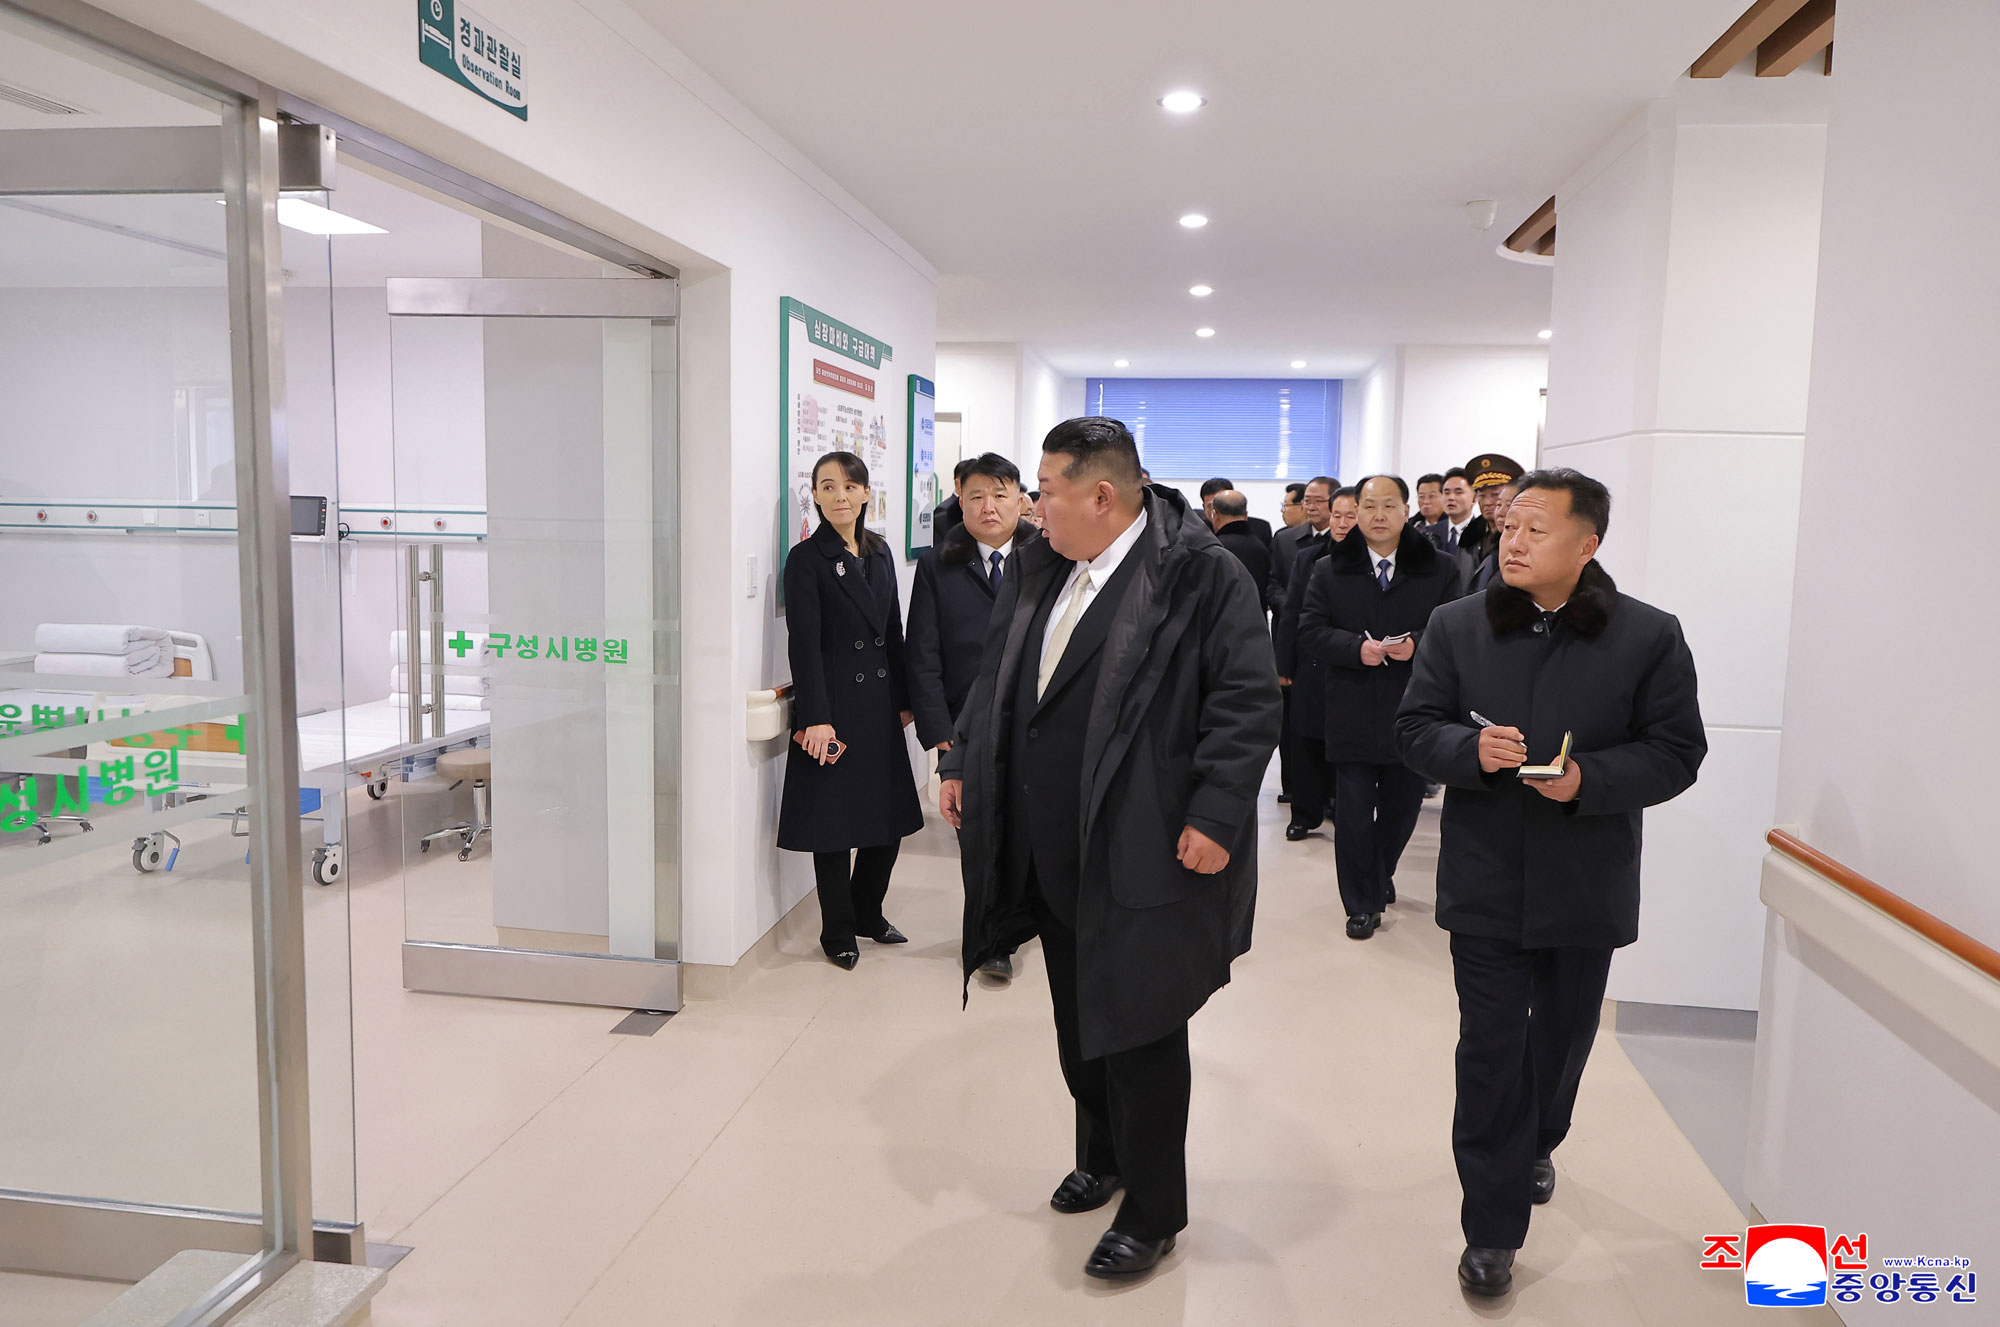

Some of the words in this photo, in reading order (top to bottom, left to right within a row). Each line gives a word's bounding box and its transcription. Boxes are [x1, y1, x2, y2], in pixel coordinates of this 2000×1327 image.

[460, 17, 521, 80] 경과관찰실
[462, 53, 503, 90] Observation
[505, 80, 521, 101] Room
[814, 319, 849, 351] 심장마비와
[852, 336, 876, 363] 구급대책
[487, 632, 628, 664] 구성시병원
